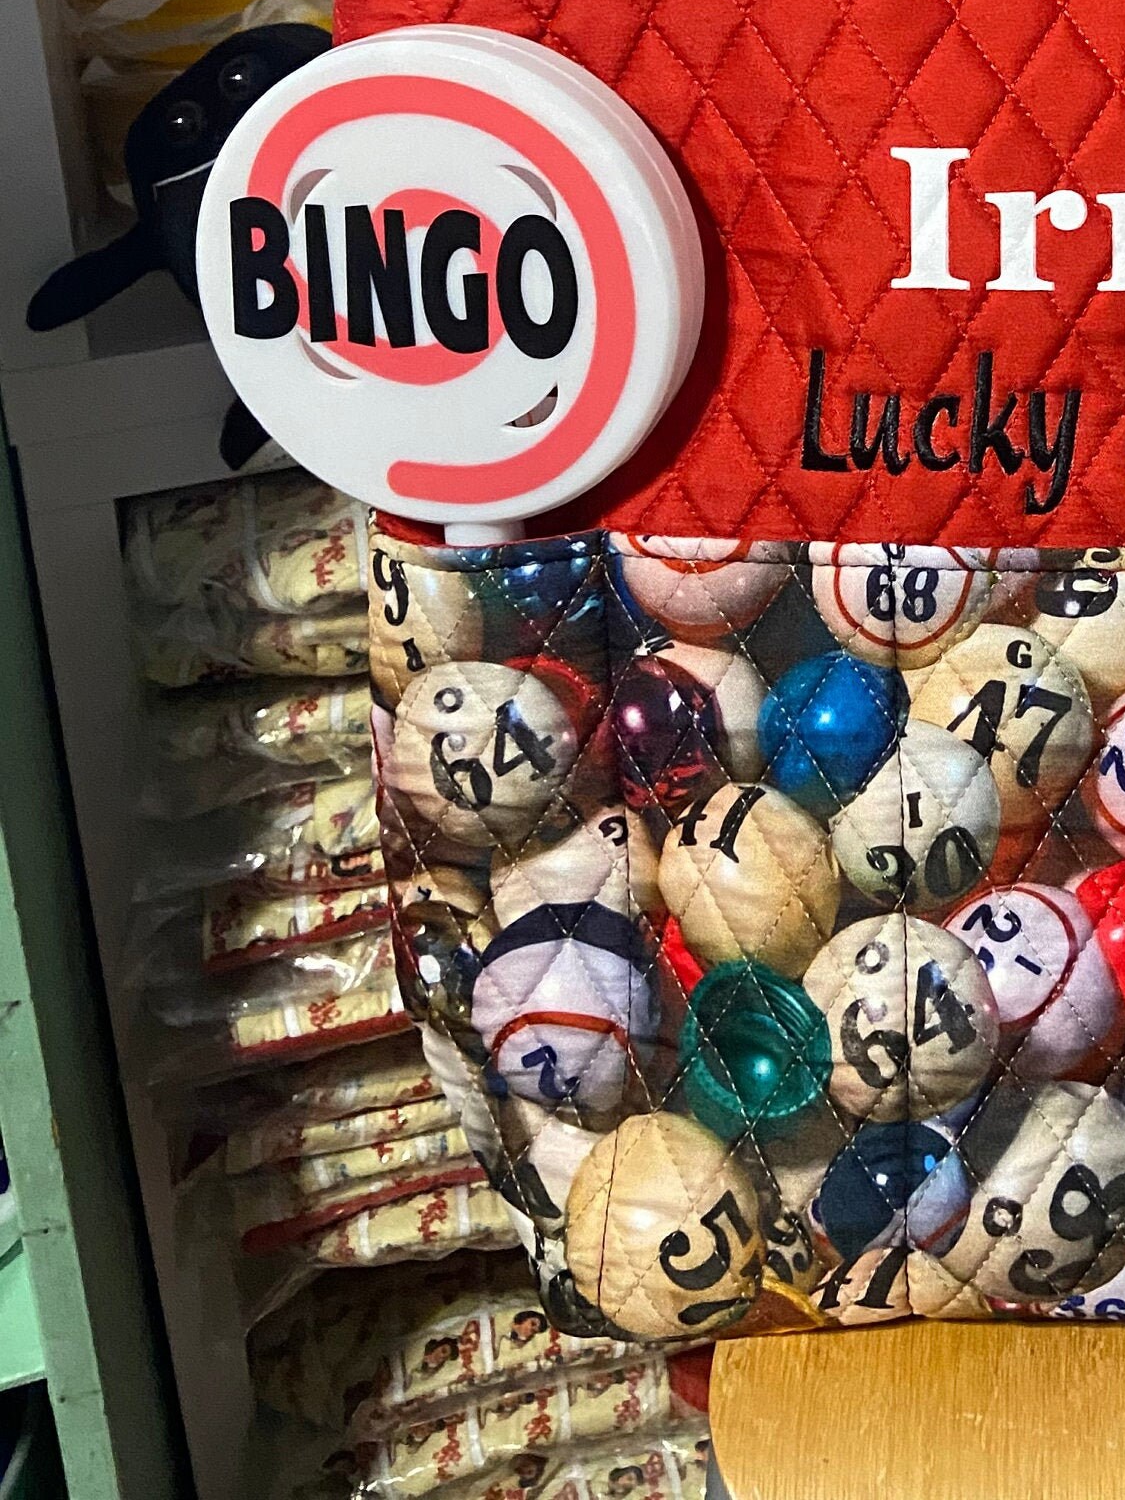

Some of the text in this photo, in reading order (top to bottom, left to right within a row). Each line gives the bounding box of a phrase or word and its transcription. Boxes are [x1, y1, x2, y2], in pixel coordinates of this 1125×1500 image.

[229, 196, 579, 360] BINGO
[800, 347, 1082, 516] Lucky
[1006, 639, 1033, 670] G
[429, 698, 557, 812] 64
[840, 958, 978, 1089] 64
